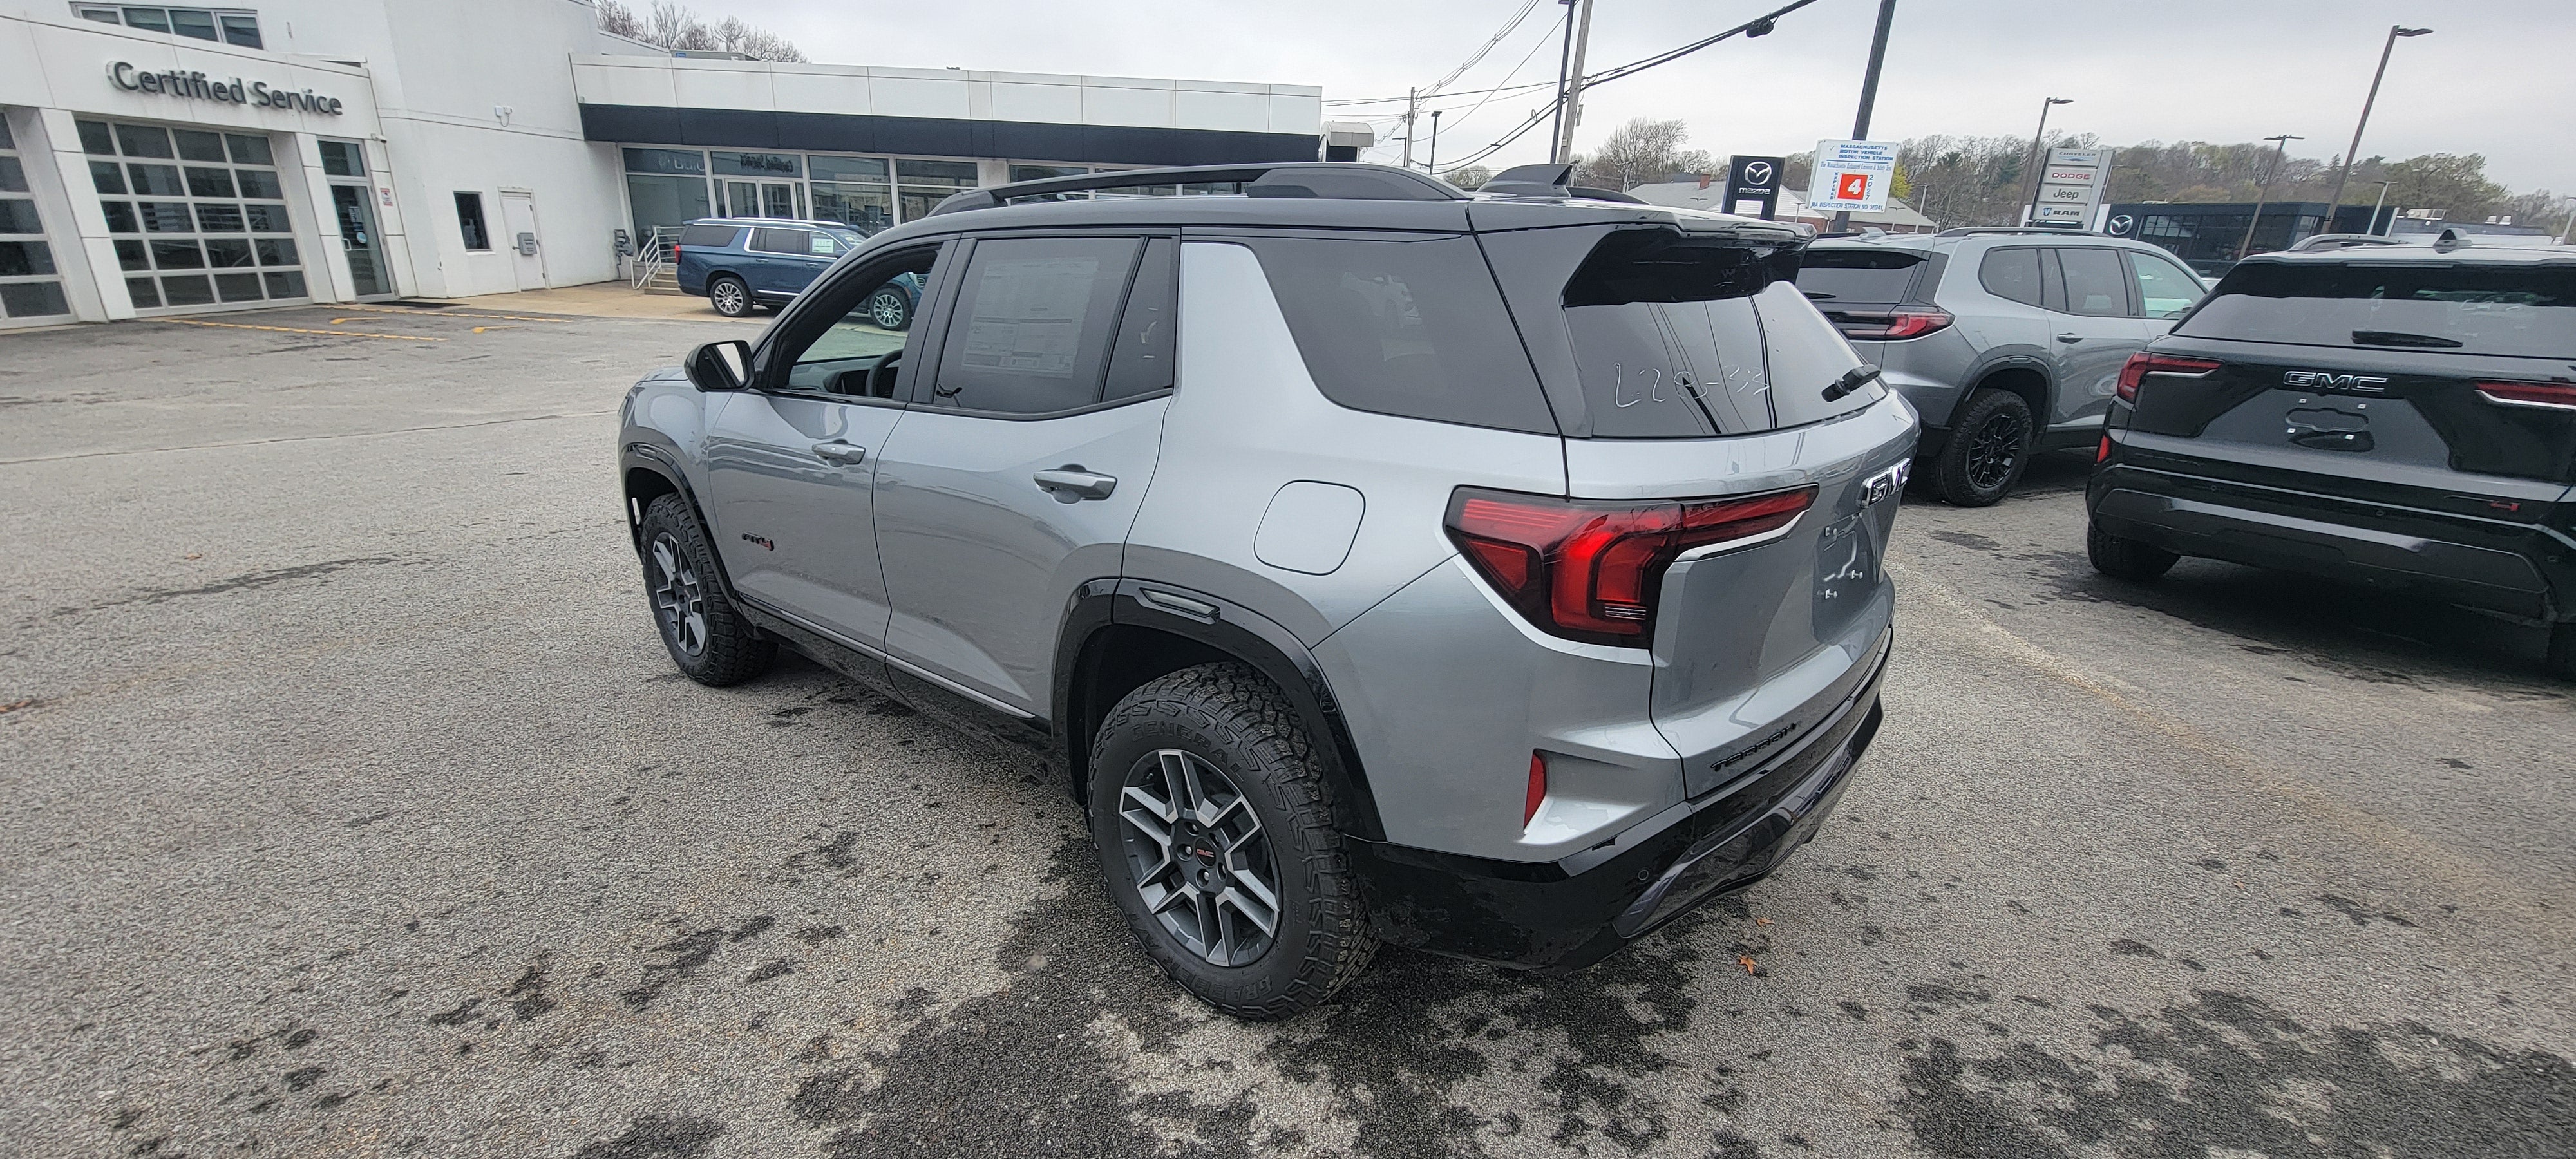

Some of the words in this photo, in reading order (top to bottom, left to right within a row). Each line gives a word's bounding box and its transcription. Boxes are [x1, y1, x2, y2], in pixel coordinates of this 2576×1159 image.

[106, 61, 247, 104] Certified
[249, 81, 343, 115] Service
[1848, 179, 1861, 195] 4
[2053, 188, 2079, 200] Jeep
[2283, 370, 2388, 393] GMC
[1196, 848, 1215, 858] GMC
